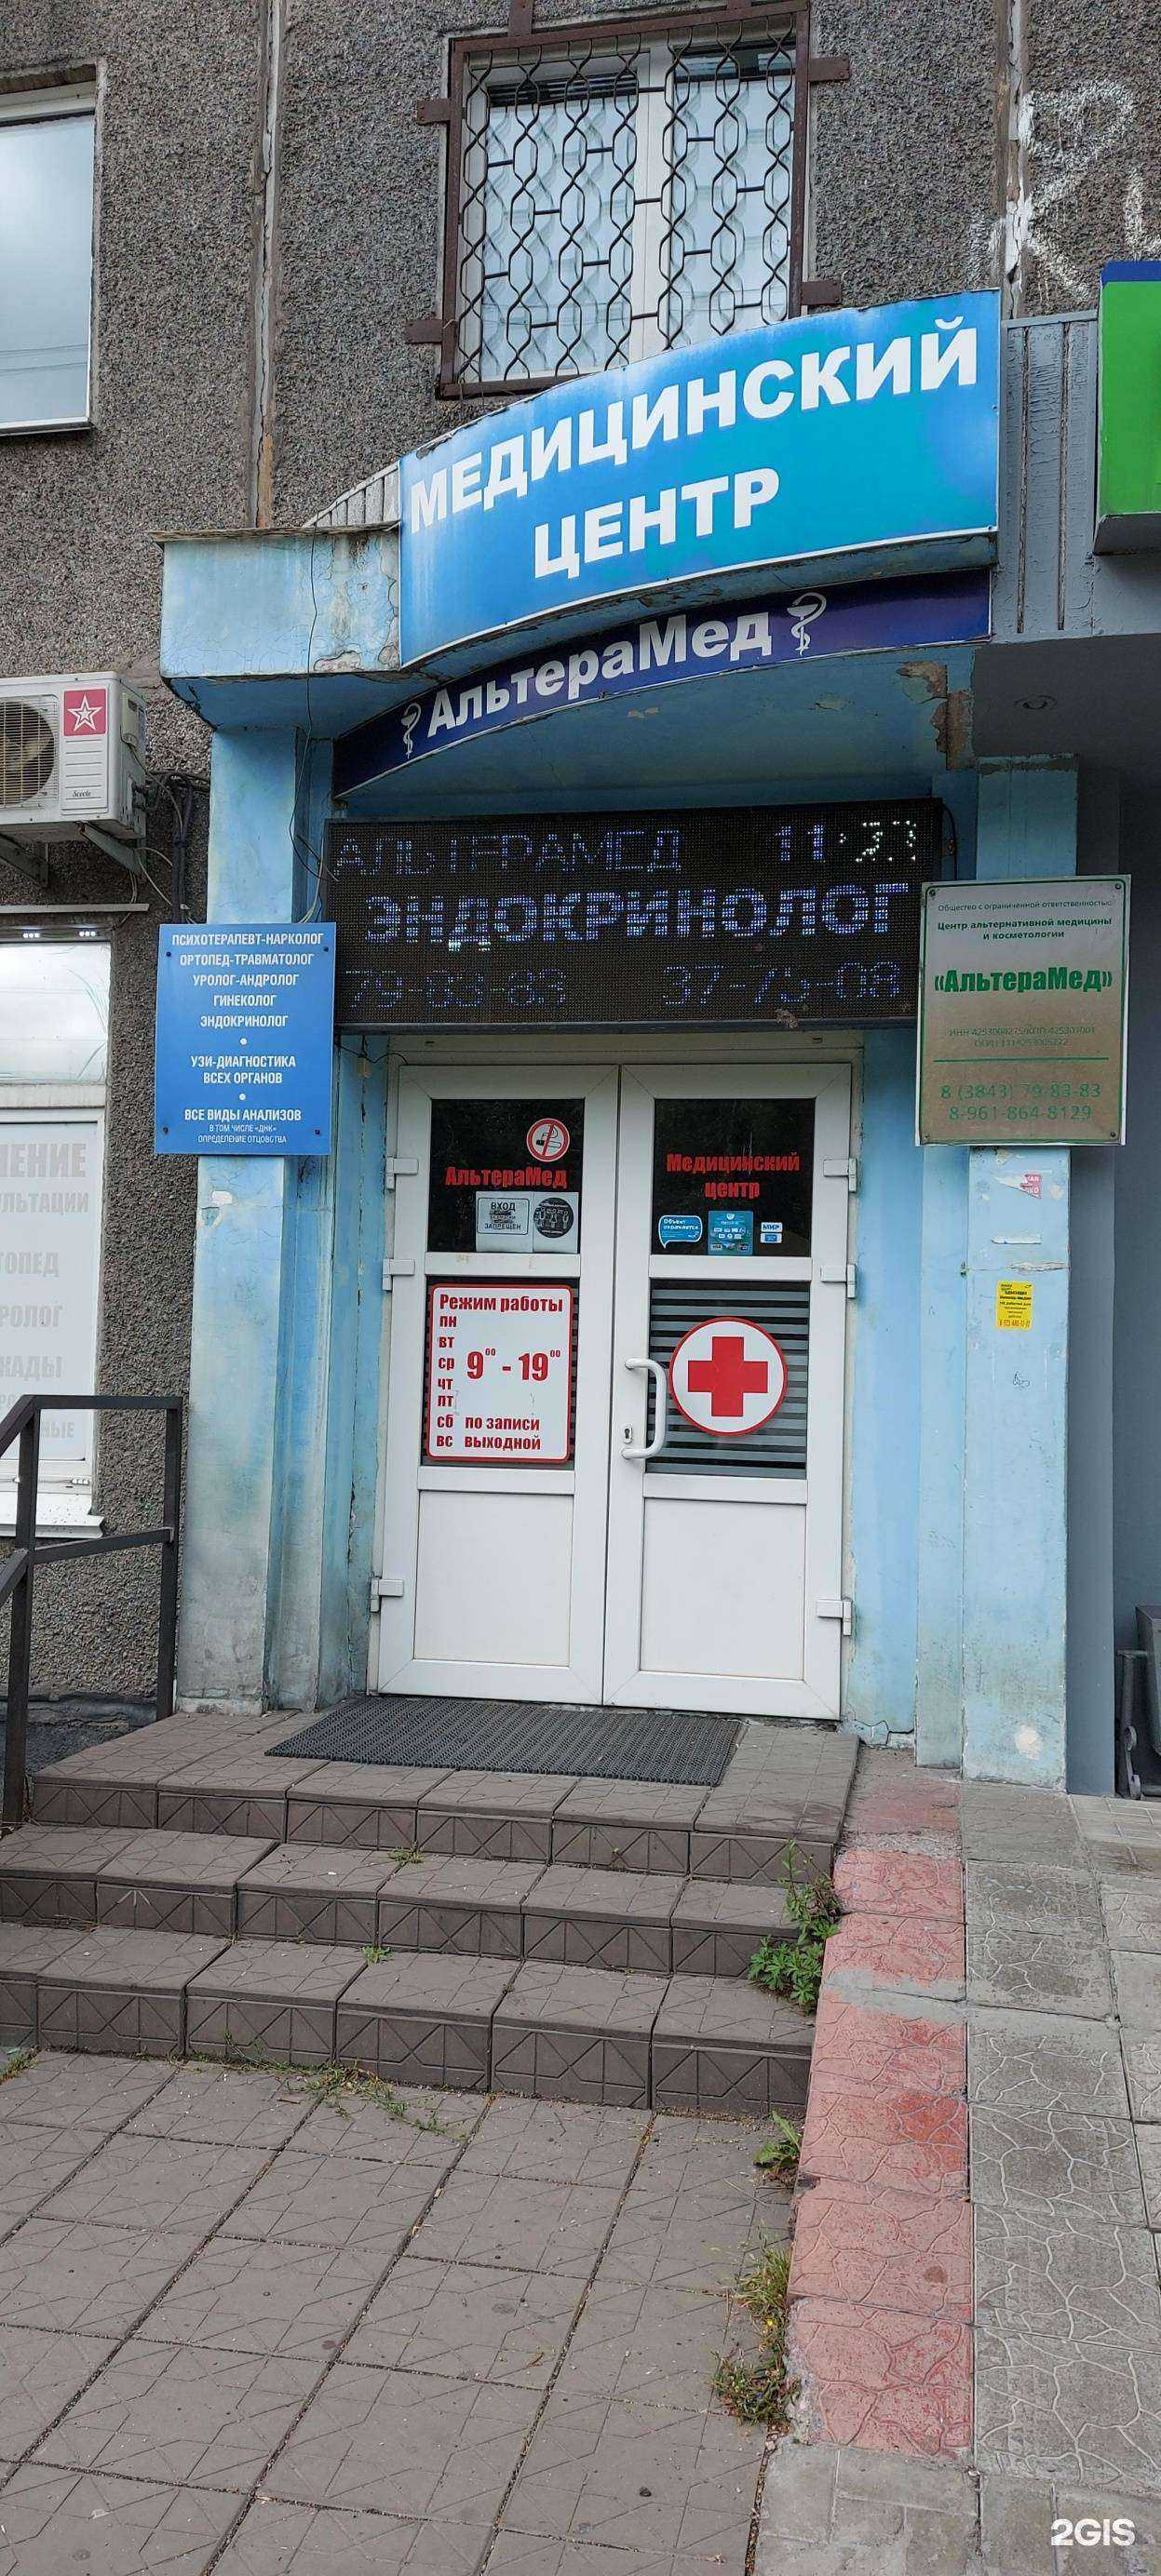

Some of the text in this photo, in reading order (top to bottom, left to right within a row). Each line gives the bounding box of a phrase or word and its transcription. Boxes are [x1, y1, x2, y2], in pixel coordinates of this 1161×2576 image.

[411, 315, 978, 534] МЕДИЦИНСКИЙ
[533, 467, 780, 582] ЦЕНТР
[425, 610, 773, 738] АльтераМед
[984, 901, 1040, 912] ограниченной
[365, 883, 910, 952] ЭНДОКРИНОЛОГ
[938, 918, 1112, 931] Центр альтернативной медицины
[172, 932, 324, 946] ПСИХОТЕРАПЕВТ-НАРКОЛОГ
[982, 931, 1064, 941] и косметологии
[180, 953, 314, 967] ОРТОПЕД-ТРАВМАТОЛОГ
[193, 973, 300, 987] УРОЛОГ-АНДРОЛОГ
[934, 966, 1113, 993] «АльтераМед»
[213, 994, 277, 1007] ГИНЕКОЛОГ
[200, 1014, 289, 1029] ЭНДОКРИНОЛОГ
[191, 1055, 296, 1069] УЗИ-ДИАГНОСТИКА
[203, 1072, 283, 1084] ВСЕХ ОРГАНОВ
[940, 1082, 1101, 1101] 8 (3843) 79-83-83
[184, 1108, 302, 1122] ВСЕ ВИДЫ АНАЛИЗОВ
[949, 1105, 1093, 1120] 8-961-864-8129
[215, 1124, 230, 1133] ТОМ
[231, 1124, 253, 1133] ЧИСЛЕ
[197, 1134, 287, 1144] ОПРЕДЕЛЕНИЕ ОТЦОВСТВА
[666, 1151, 801, 1174] Медицинский
[444, 1166, 568, 1189] АльтераМед
[704, 1182, 760, 1201] центр
[491, 1201, 516, 1212] ВХОД
[484, 1222, 521, 1230] ЗАПРЕЩЕН
[439, 1294, 563, 1313] Режим работы
[439, 1315, 457, 1328] пн
[439, 1336, 455, 1348] вт
[438, 1357, 455, 1371] ср
[438, 1377, 453, 1390] чт
[438, 1395, 454, 1407] пт
[437, 1415, 540, 1431] сб по записи
[436, 1434, 541, 1452] вс выходной
